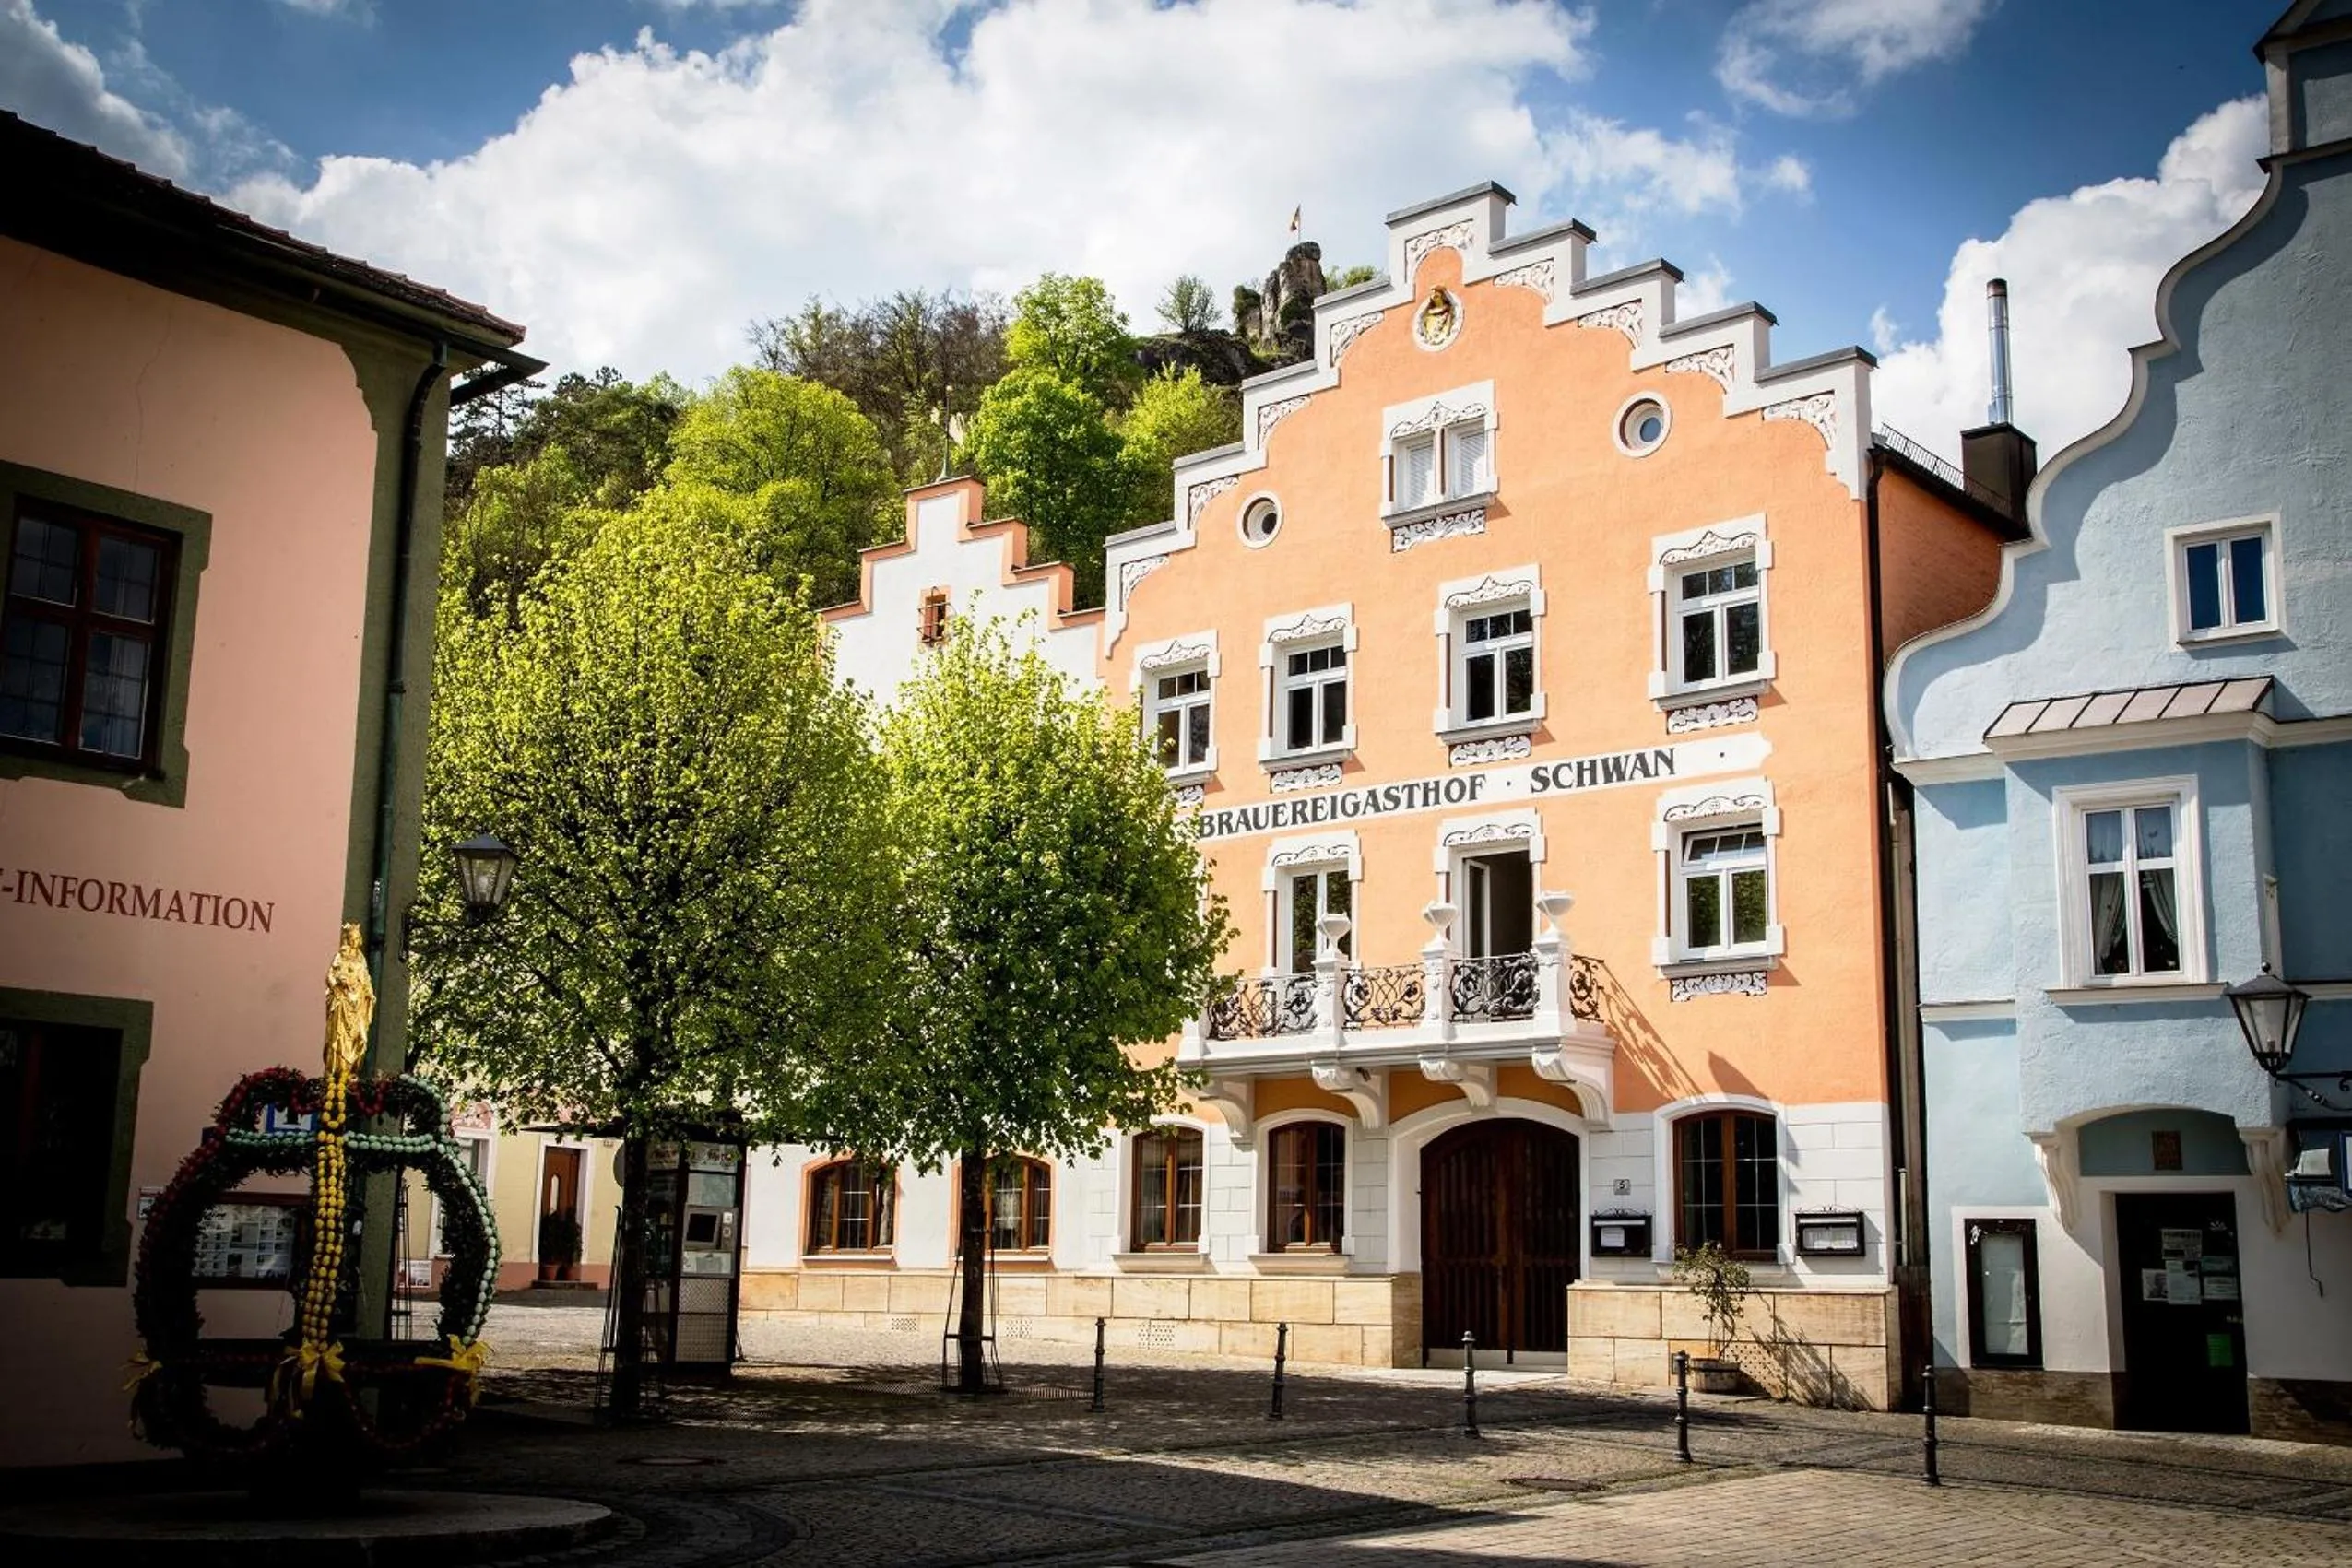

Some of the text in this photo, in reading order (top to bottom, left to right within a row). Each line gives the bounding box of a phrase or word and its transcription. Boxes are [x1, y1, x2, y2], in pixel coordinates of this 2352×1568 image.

[1199, 747, 1676, 838] BRAUEREIGASTHOF SCHWAN
[0, 867, 275, 933] -INFORMATION
